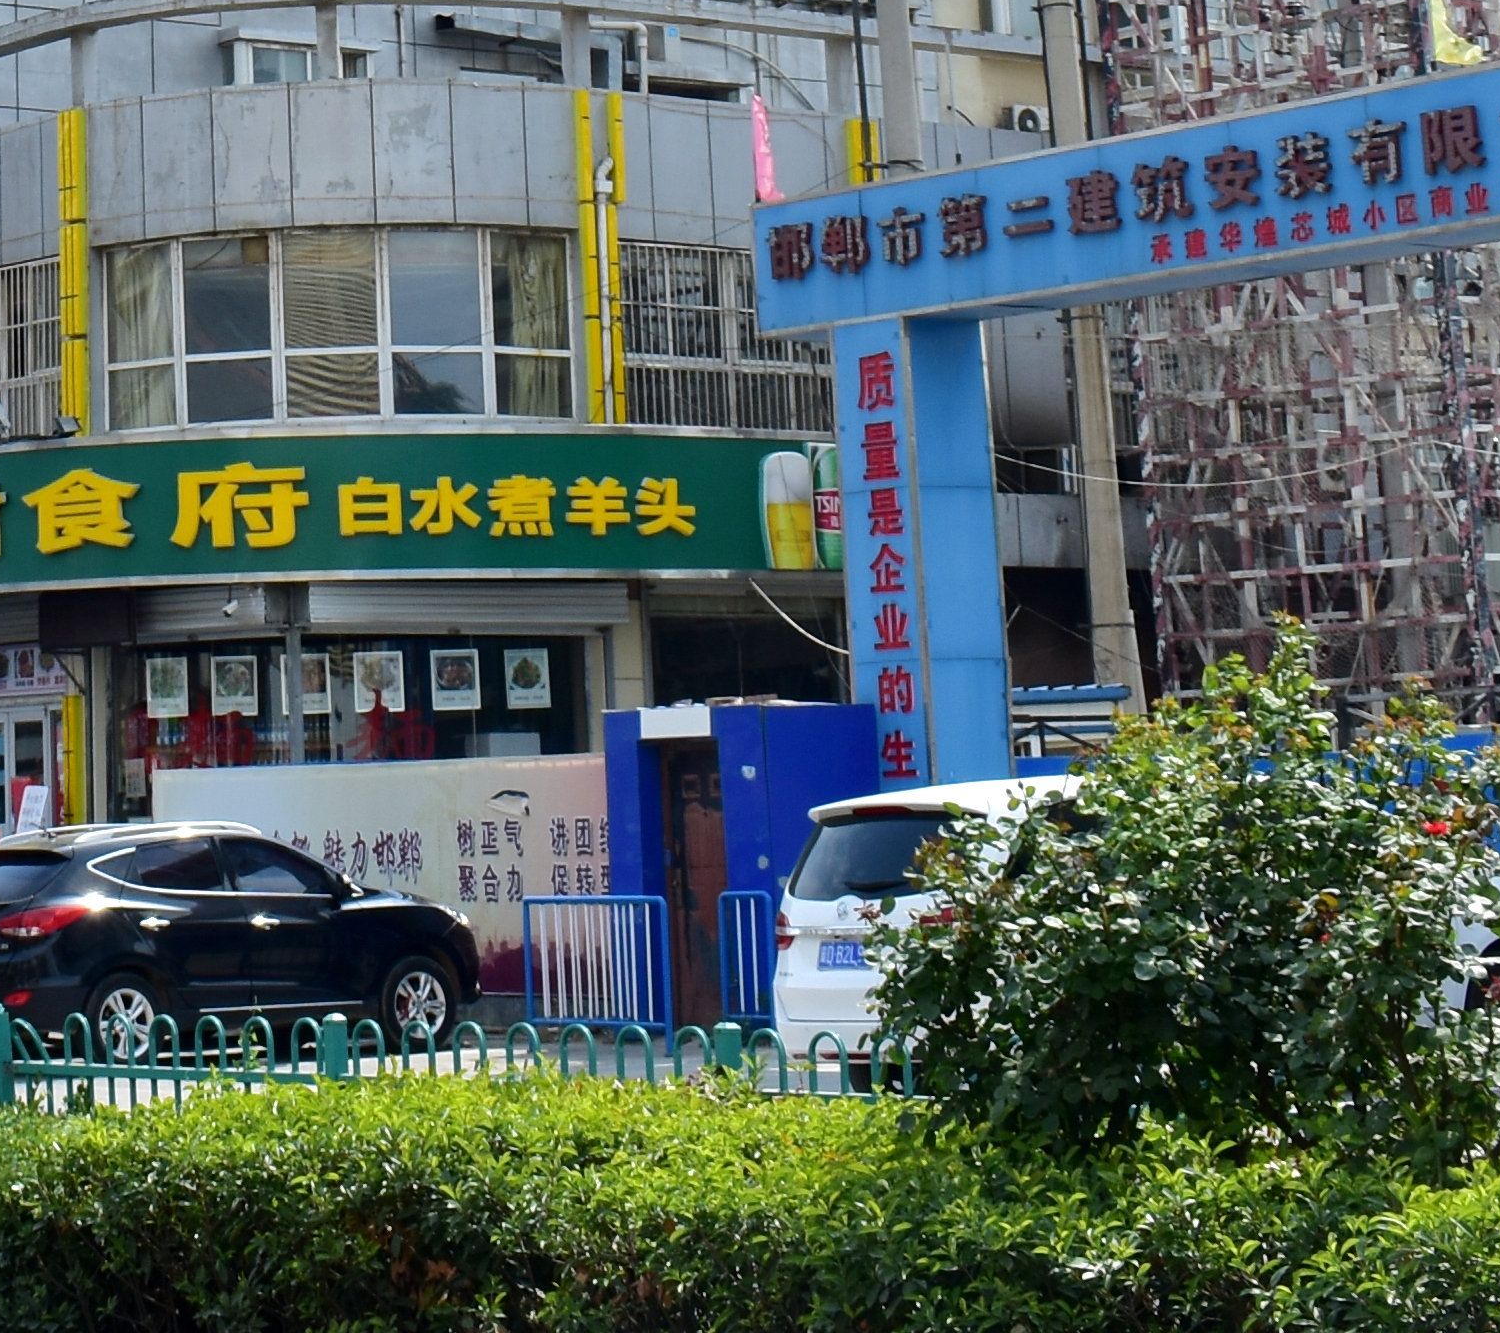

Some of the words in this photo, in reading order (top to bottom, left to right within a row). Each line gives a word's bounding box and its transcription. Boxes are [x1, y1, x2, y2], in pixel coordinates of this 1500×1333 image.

[338, 475, 697, 539] 白水煮羊头
[456, 819, 525, 856] 树正气
[458, 864, 524, 902] 聚合力
